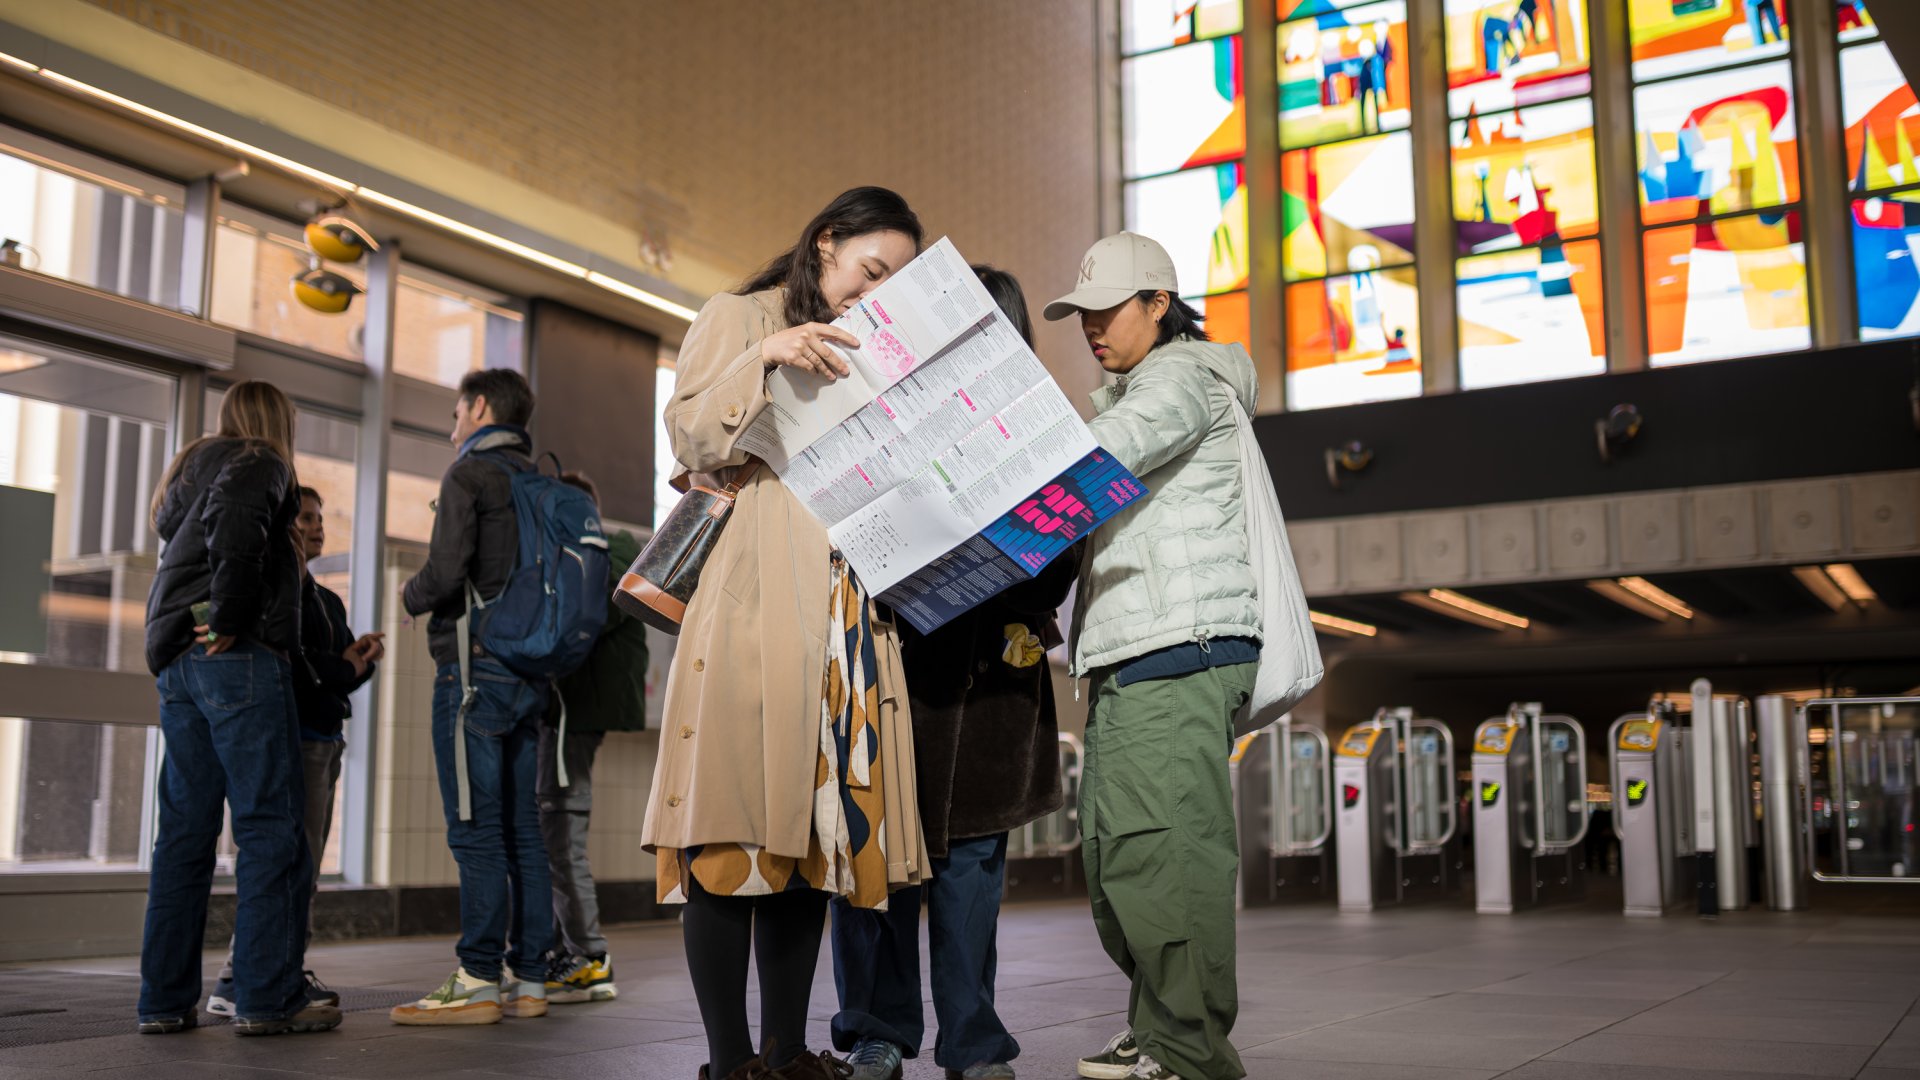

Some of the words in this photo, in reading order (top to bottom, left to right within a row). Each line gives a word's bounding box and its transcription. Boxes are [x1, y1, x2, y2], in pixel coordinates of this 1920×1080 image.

[1110, 481, 1132, 501] design
[1121, 479, 1140, 497] dutch
[1107, 490, 1124, 506] week
